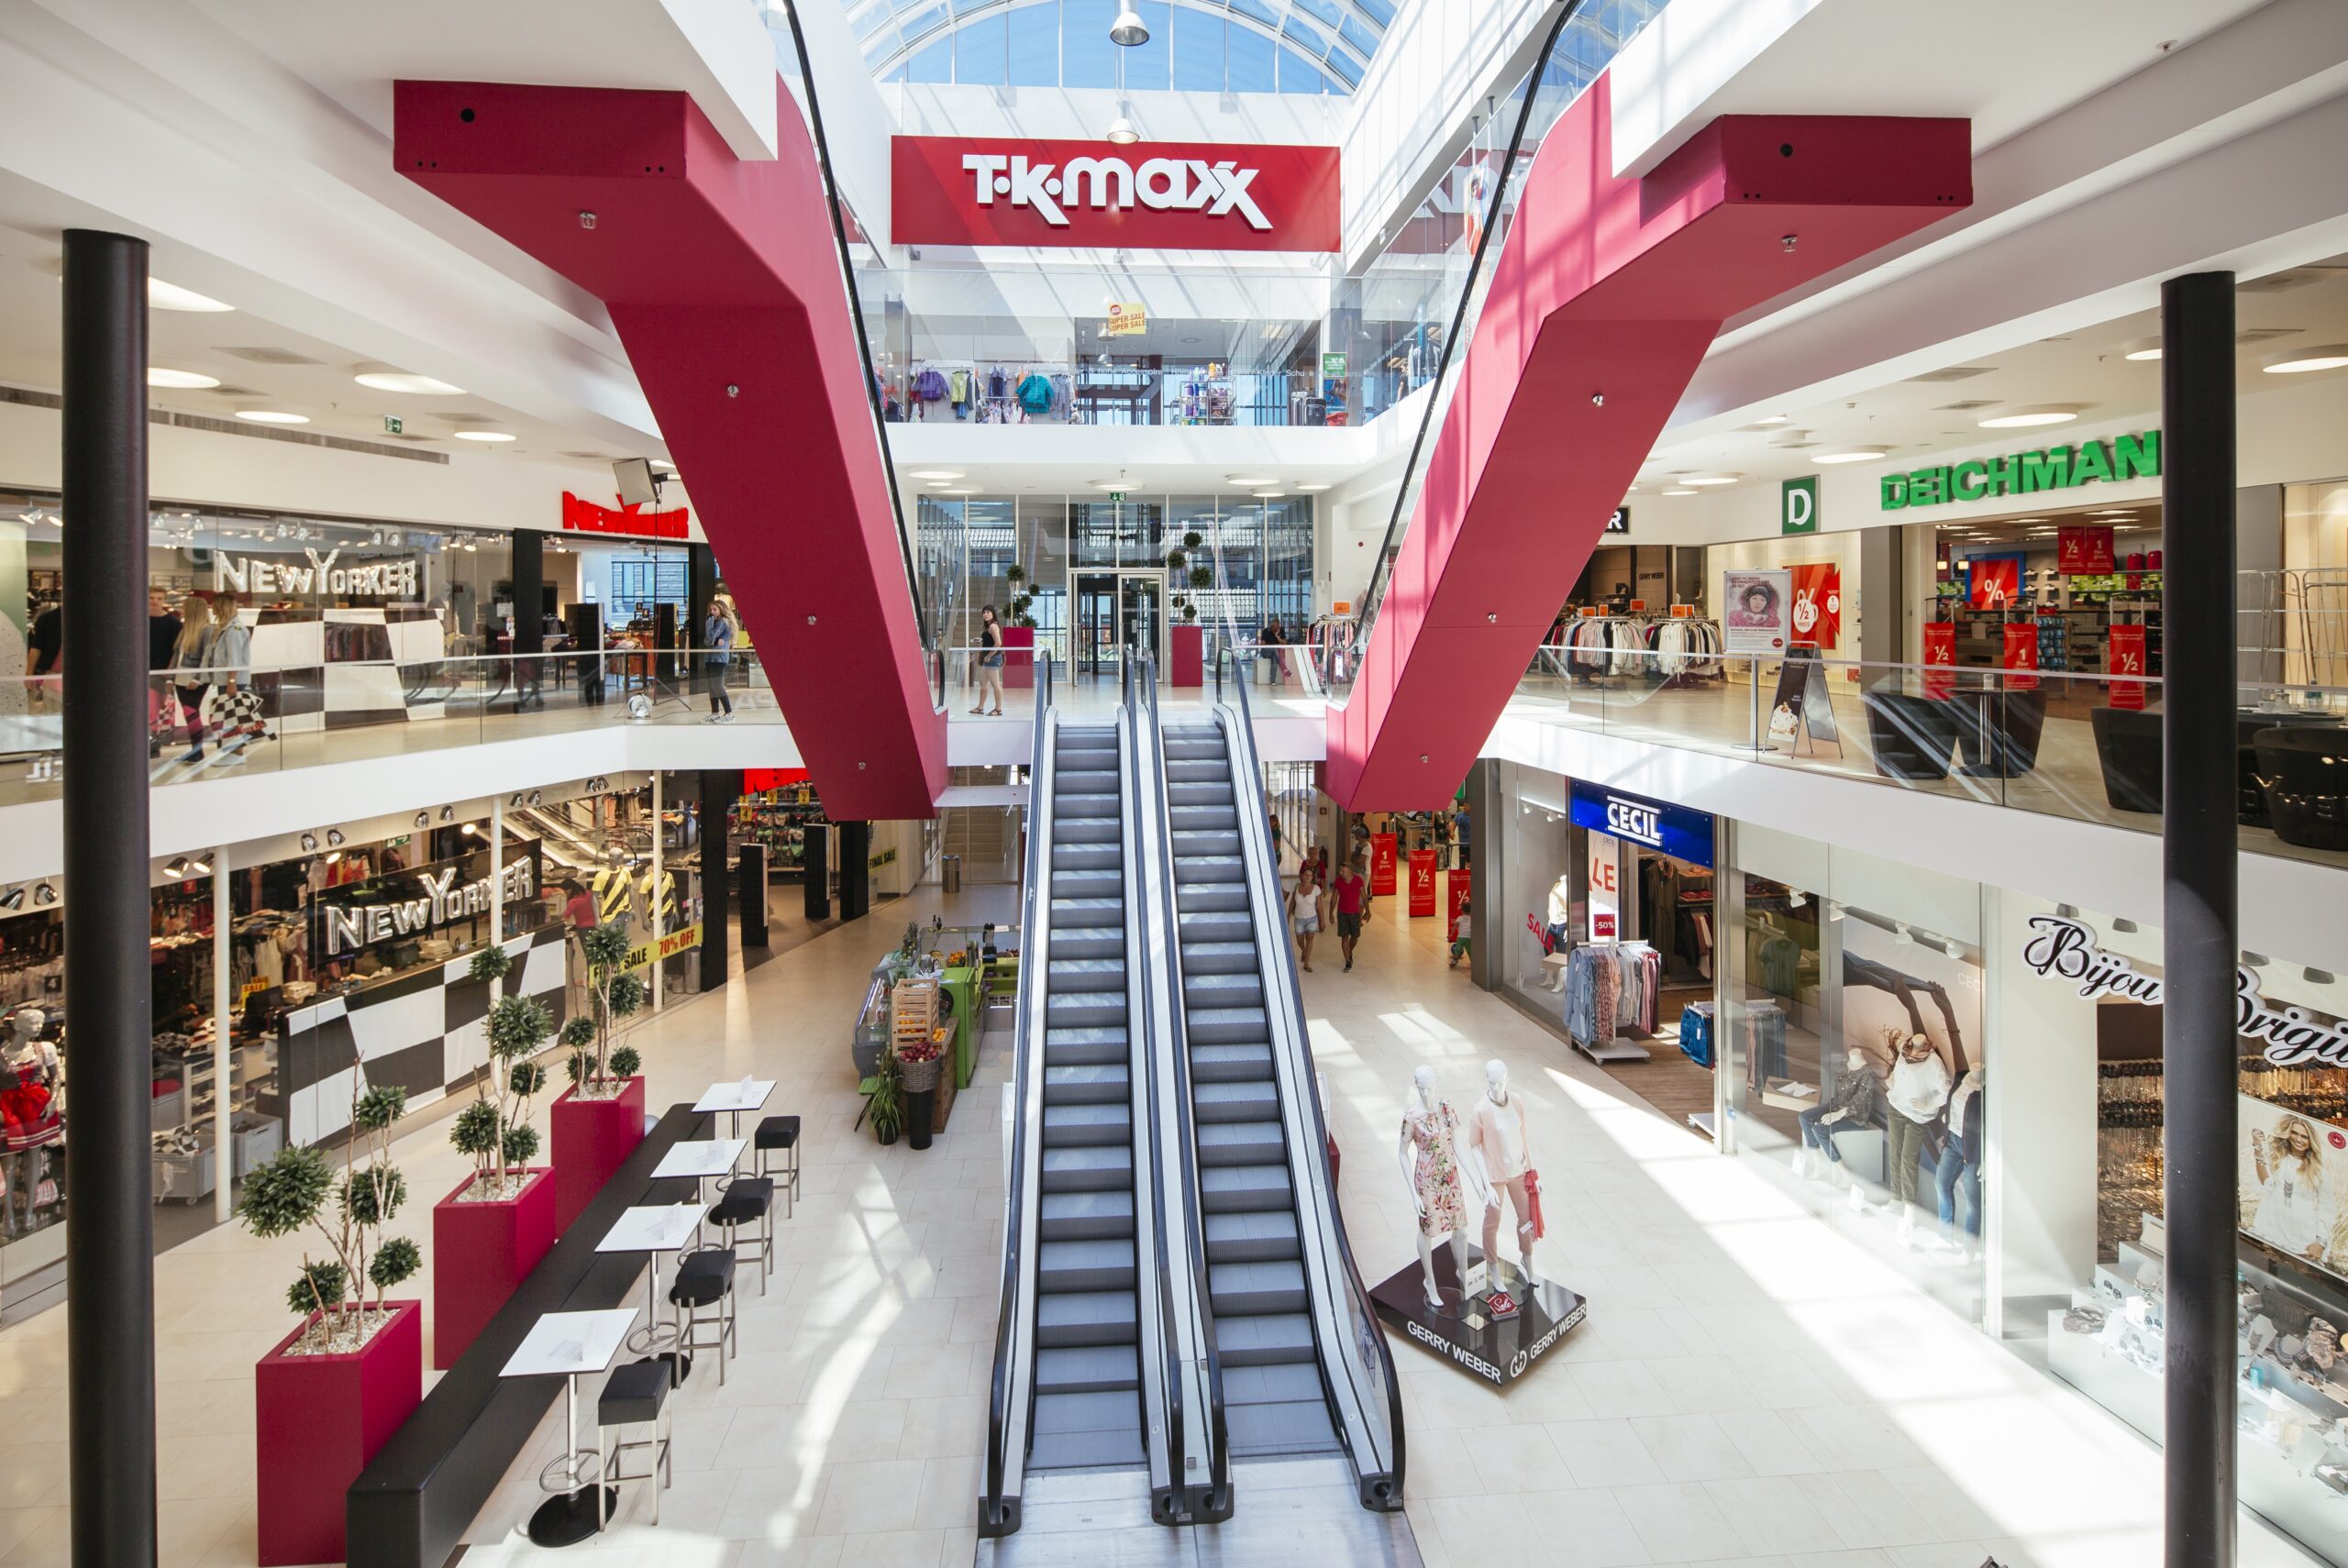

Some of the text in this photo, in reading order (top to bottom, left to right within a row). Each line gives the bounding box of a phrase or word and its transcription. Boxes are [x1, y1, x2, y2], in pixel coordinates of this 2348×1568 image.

[1109, 312, 1146, 325] SUPER SALE
[1788, 489, 1812, 525] D
[1607, 802, 1663, 839] CECIL
[884, 849, 896, 864] SALE
[1527, 912, 1556, 954] SALE
[1595, 921, 1615, 930] -50%
[625, 948, 648, 970] SALE
[659, 935, 679, 955] 70%
[681, 929, 695, 947] OFF
[1494, 1297, 1512, 1312] Sale
[1530, 1303, 1587, 1360] GERRY WEBER
[1407, 1320, 1451, 1353] GERRY
[1452, 1343, 1502, 1385] WEBER
